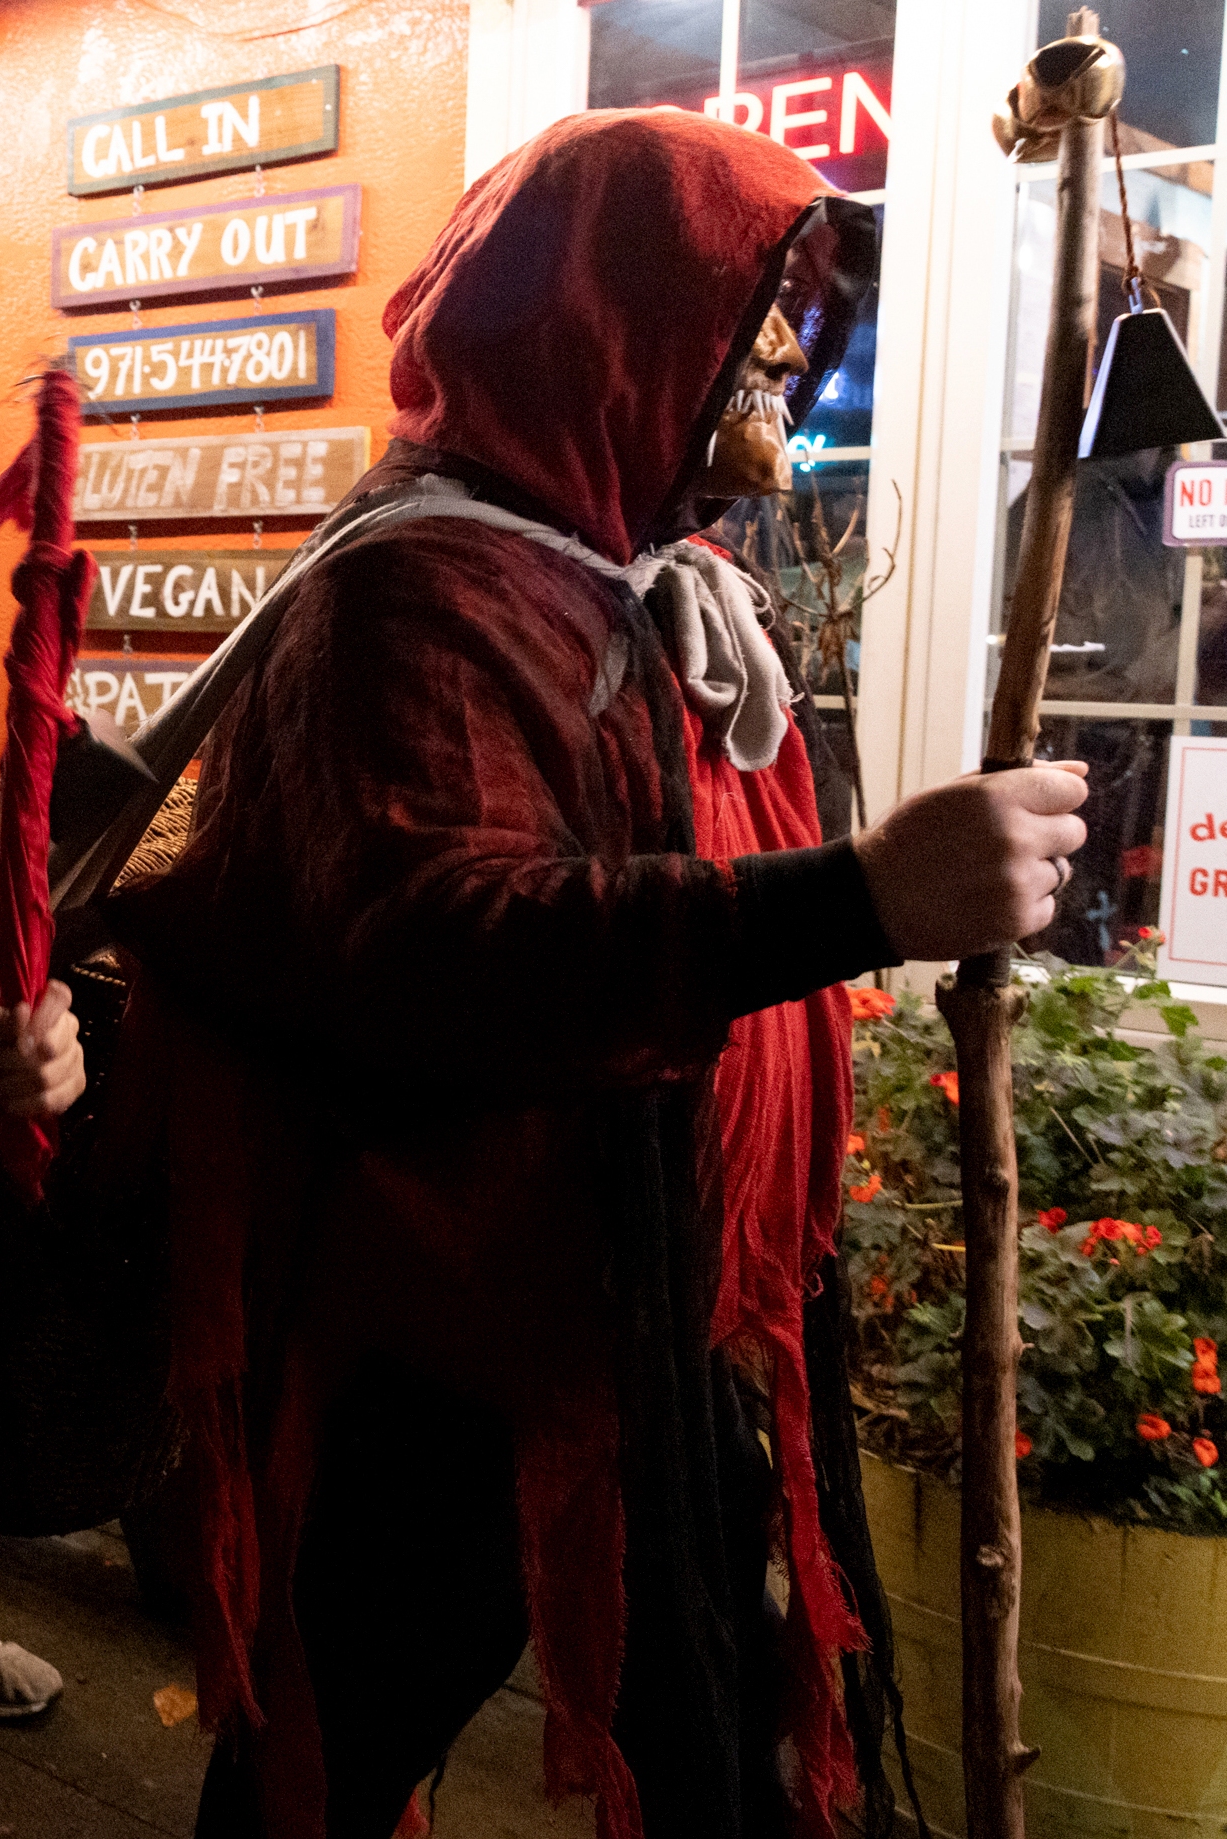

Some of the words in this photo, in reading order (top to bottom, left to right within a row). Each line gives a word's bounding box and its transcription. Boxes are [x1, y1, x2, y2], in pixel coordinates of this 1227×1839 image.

[81, 118, 184, 178] CALL
[201, 95, 261, 156] IN
[650, 71, 891, 162] PEN
[68, 222, 202, 291] CARRY
[221, 206, 317, 266] OUT
[212, 440, 329, 511] FREE
[1180, 479, 1212, 507] NO
[1188, 514, 1214, 528] LEFT
[99, 564, 266, 618] VEGAN
